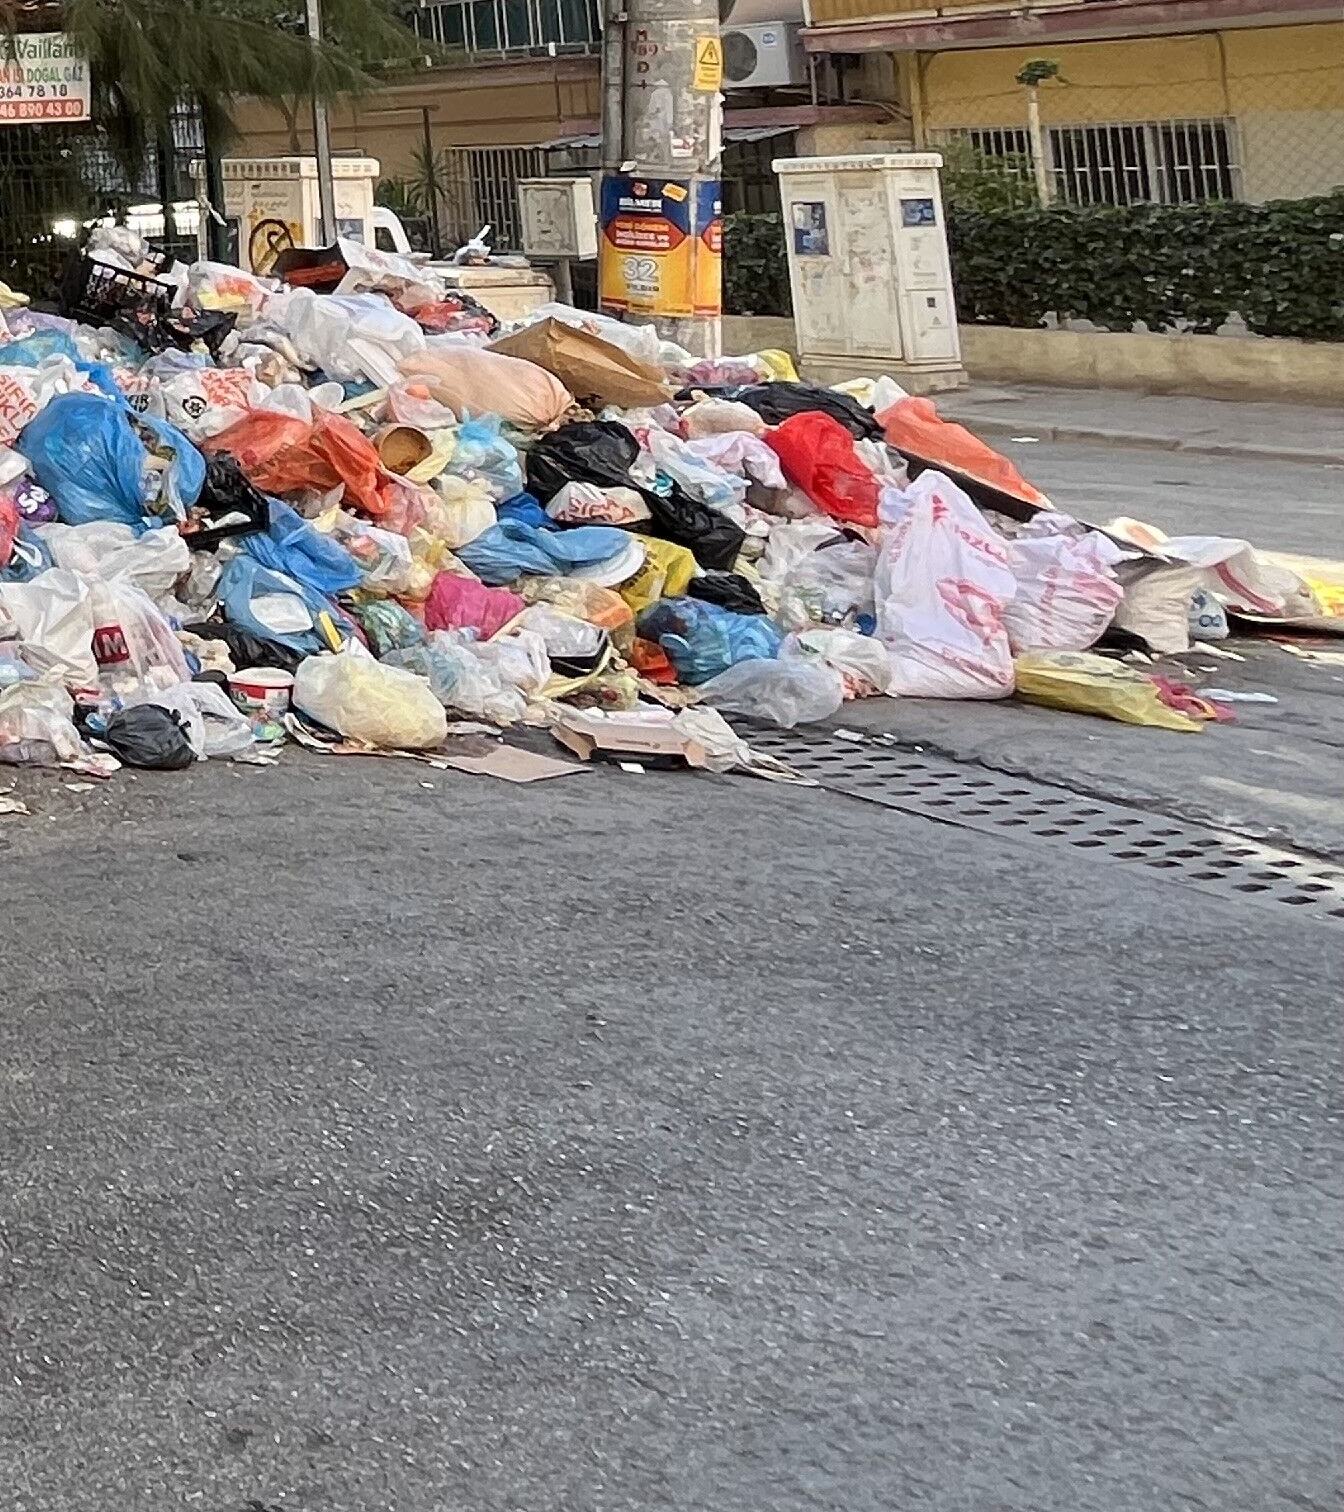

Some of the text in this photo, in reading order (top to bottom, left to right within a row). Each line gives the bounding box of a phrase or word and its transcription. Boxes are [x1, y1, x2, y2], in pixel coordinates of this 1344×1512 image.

[63, 65, 84, 82] GAZ
[27, 85, 46, 98] 78
[46, 102, 63, 116] 43
[65, 101, 82, 115] 00
